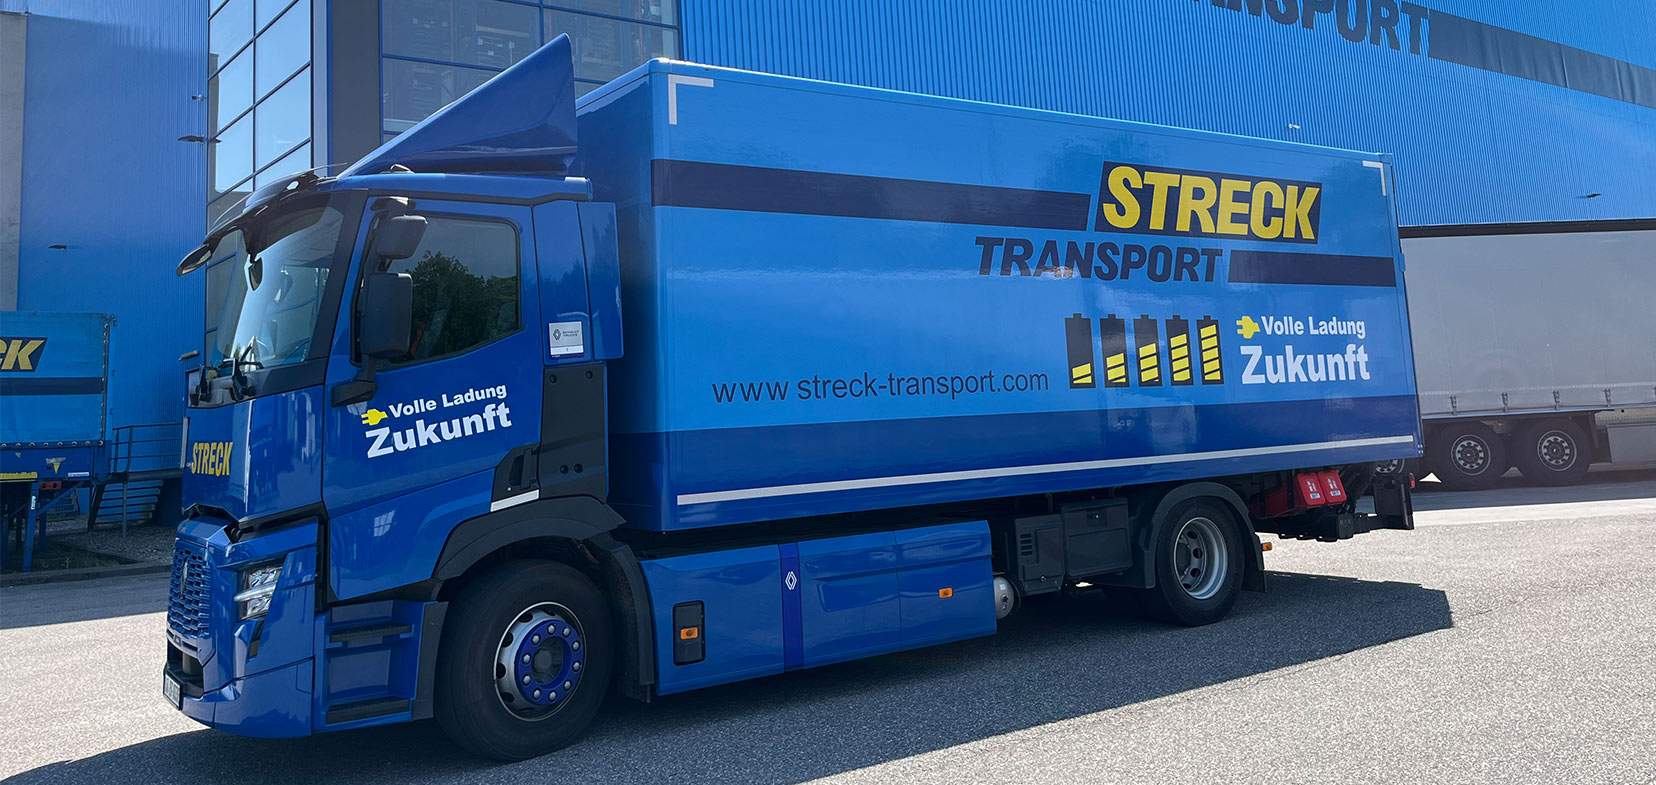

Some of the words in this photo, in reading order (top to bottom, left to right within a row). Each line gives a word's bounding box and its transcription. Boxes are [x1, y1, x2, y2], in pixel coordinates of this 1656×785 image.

[1102, 165, 1321, 241] STRECK
[975, 236, 1223, 283] TRANSPORT
[1261, 316, 1305, 335] Volle
[1308, 316, 1366, 340] Ladung
[1240, 344, 1371, 385] Zukunft
[388, 398, 437, 418] Volle
[441, 384, 508, 408] Ladung
[365, 401, 513, 459] Zukunft
[191, 441, 234, 477] STRECK
